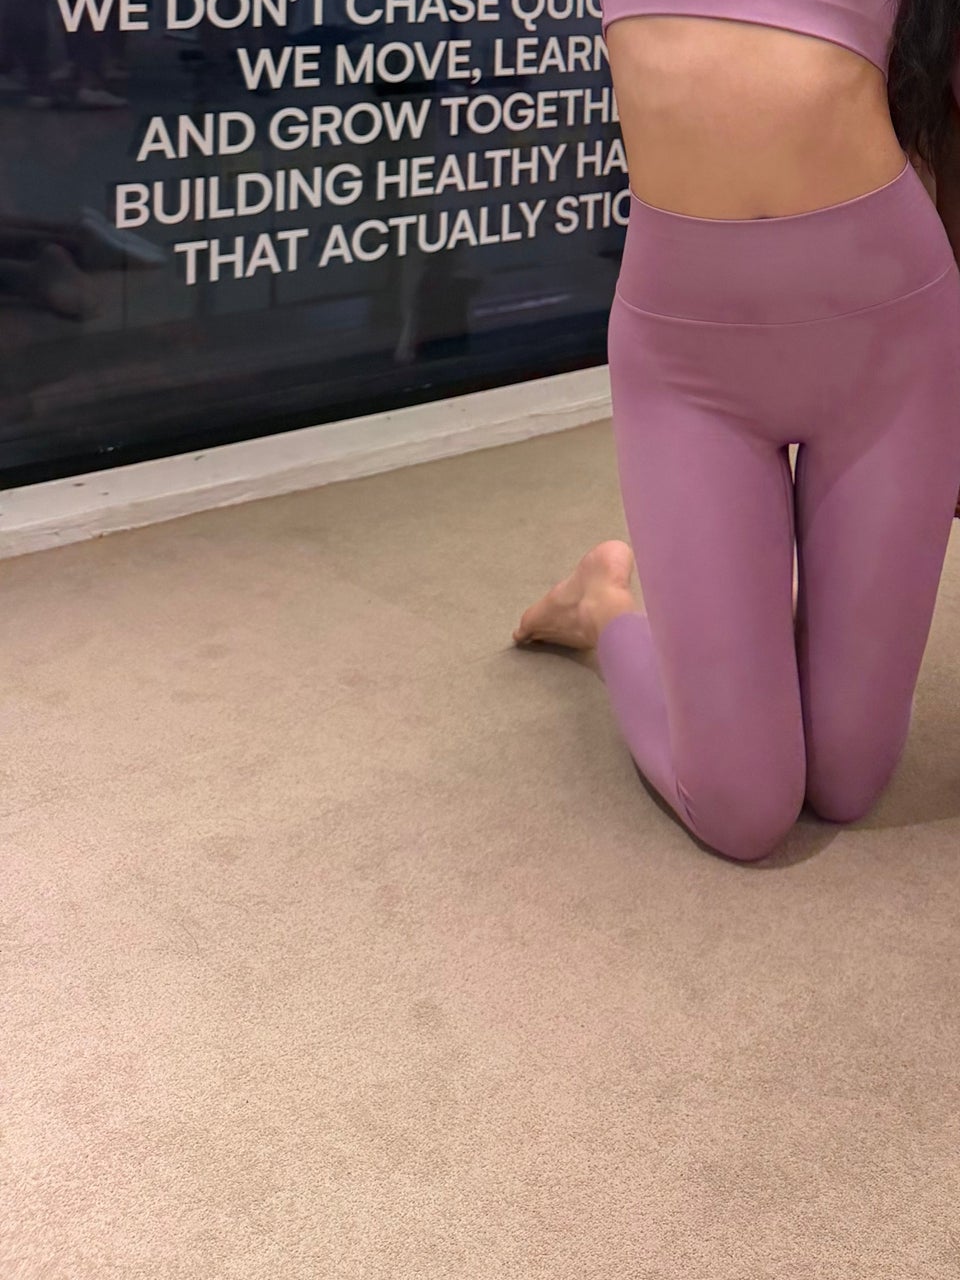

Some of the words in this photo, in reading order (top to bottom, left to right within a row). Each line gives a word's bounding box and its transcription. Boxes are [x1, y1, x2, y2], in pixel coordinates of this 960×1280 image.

[237, 45, 321, 89] WE
[336, 40, 481, 85] MOVE,
[137, 114, 255, 162] AND
[269, 99, 431, 150] GROW
[116, 163, 363, 229] BUILDING
[377, 143, 567, 200] HEALTHY
[174, 228, 309, 286] THAT
[319, 198, 546, 267] ACTUALLY
